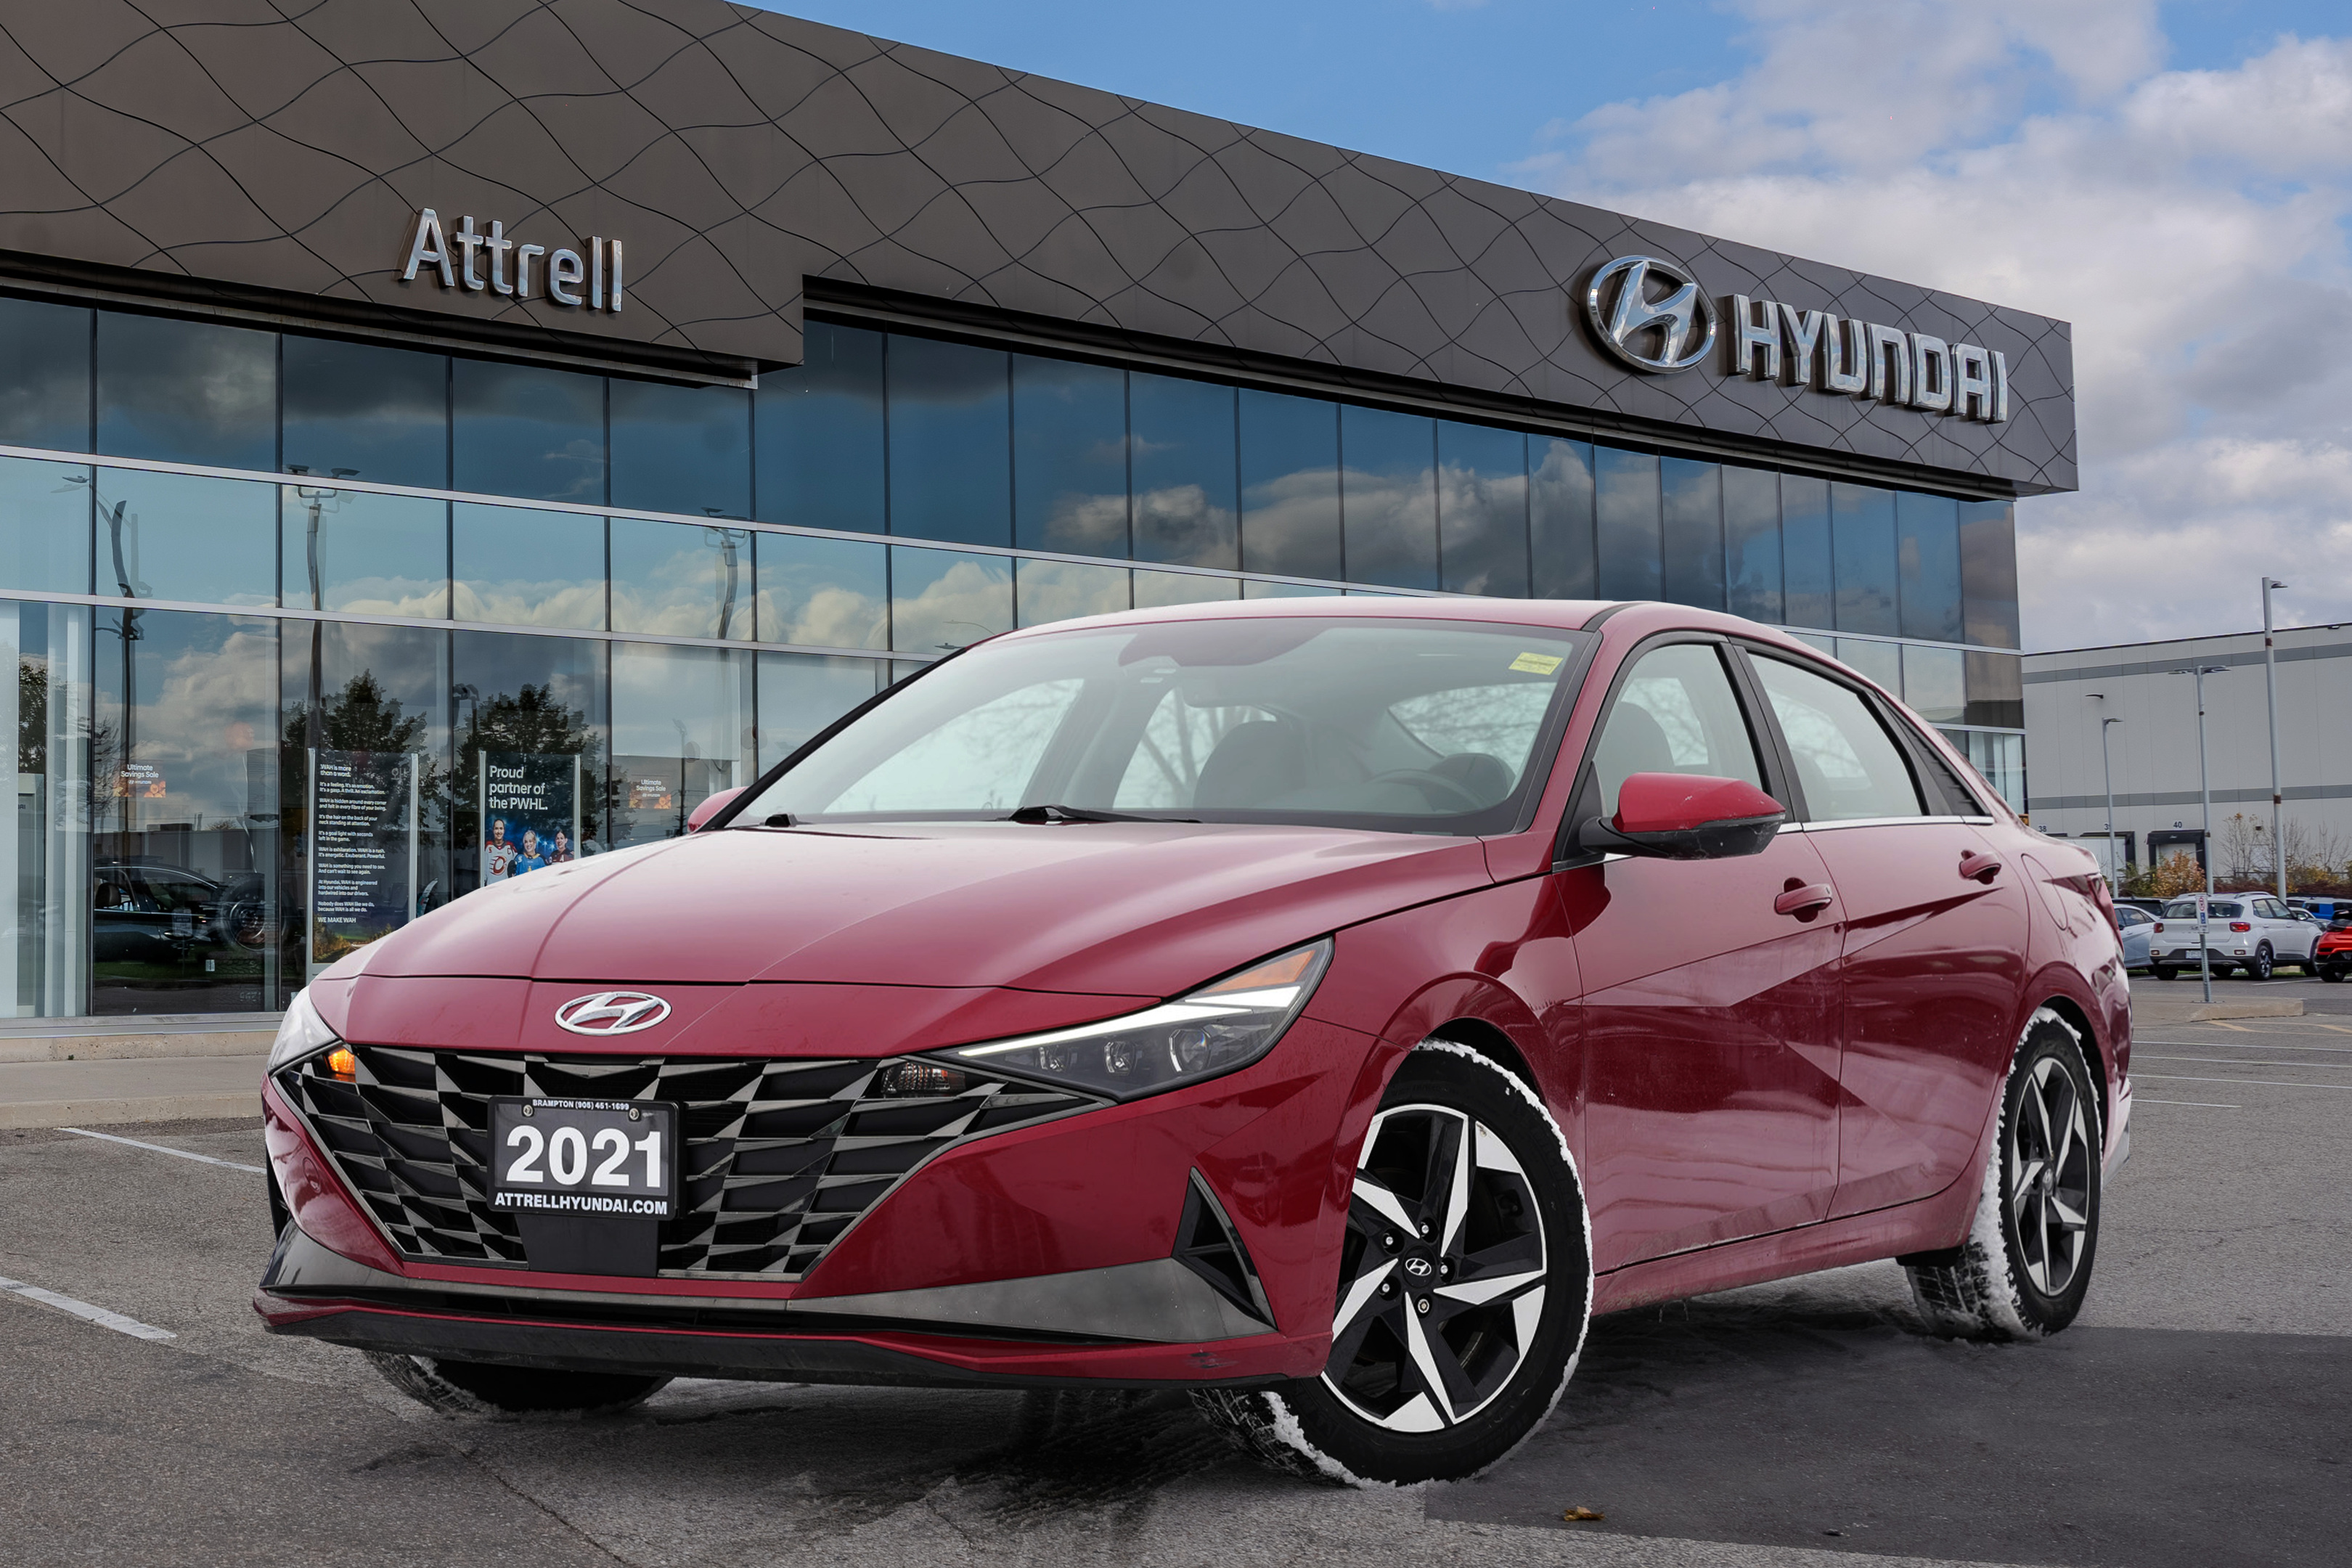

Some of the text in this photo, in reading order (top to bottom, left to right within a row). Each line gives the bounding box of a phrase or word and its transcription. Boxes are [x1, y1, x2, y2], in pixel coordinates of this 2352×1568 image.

[399, 206, 623, 313] Attrell
[1724, 293, 2009, 423] HYUNDAI
[489, 765, 524, 778] Proud
[489, 782, 546, 795] partner of
[489, 796, 548, 810] the PWHL.
[532, 1099, 629, 1110] BRAMPTON (905) 451-1699
[506, 1125, 661, 1188] 2021
[494, 1192, 668, 1215] ATTRELLHYUNDAI.COM
